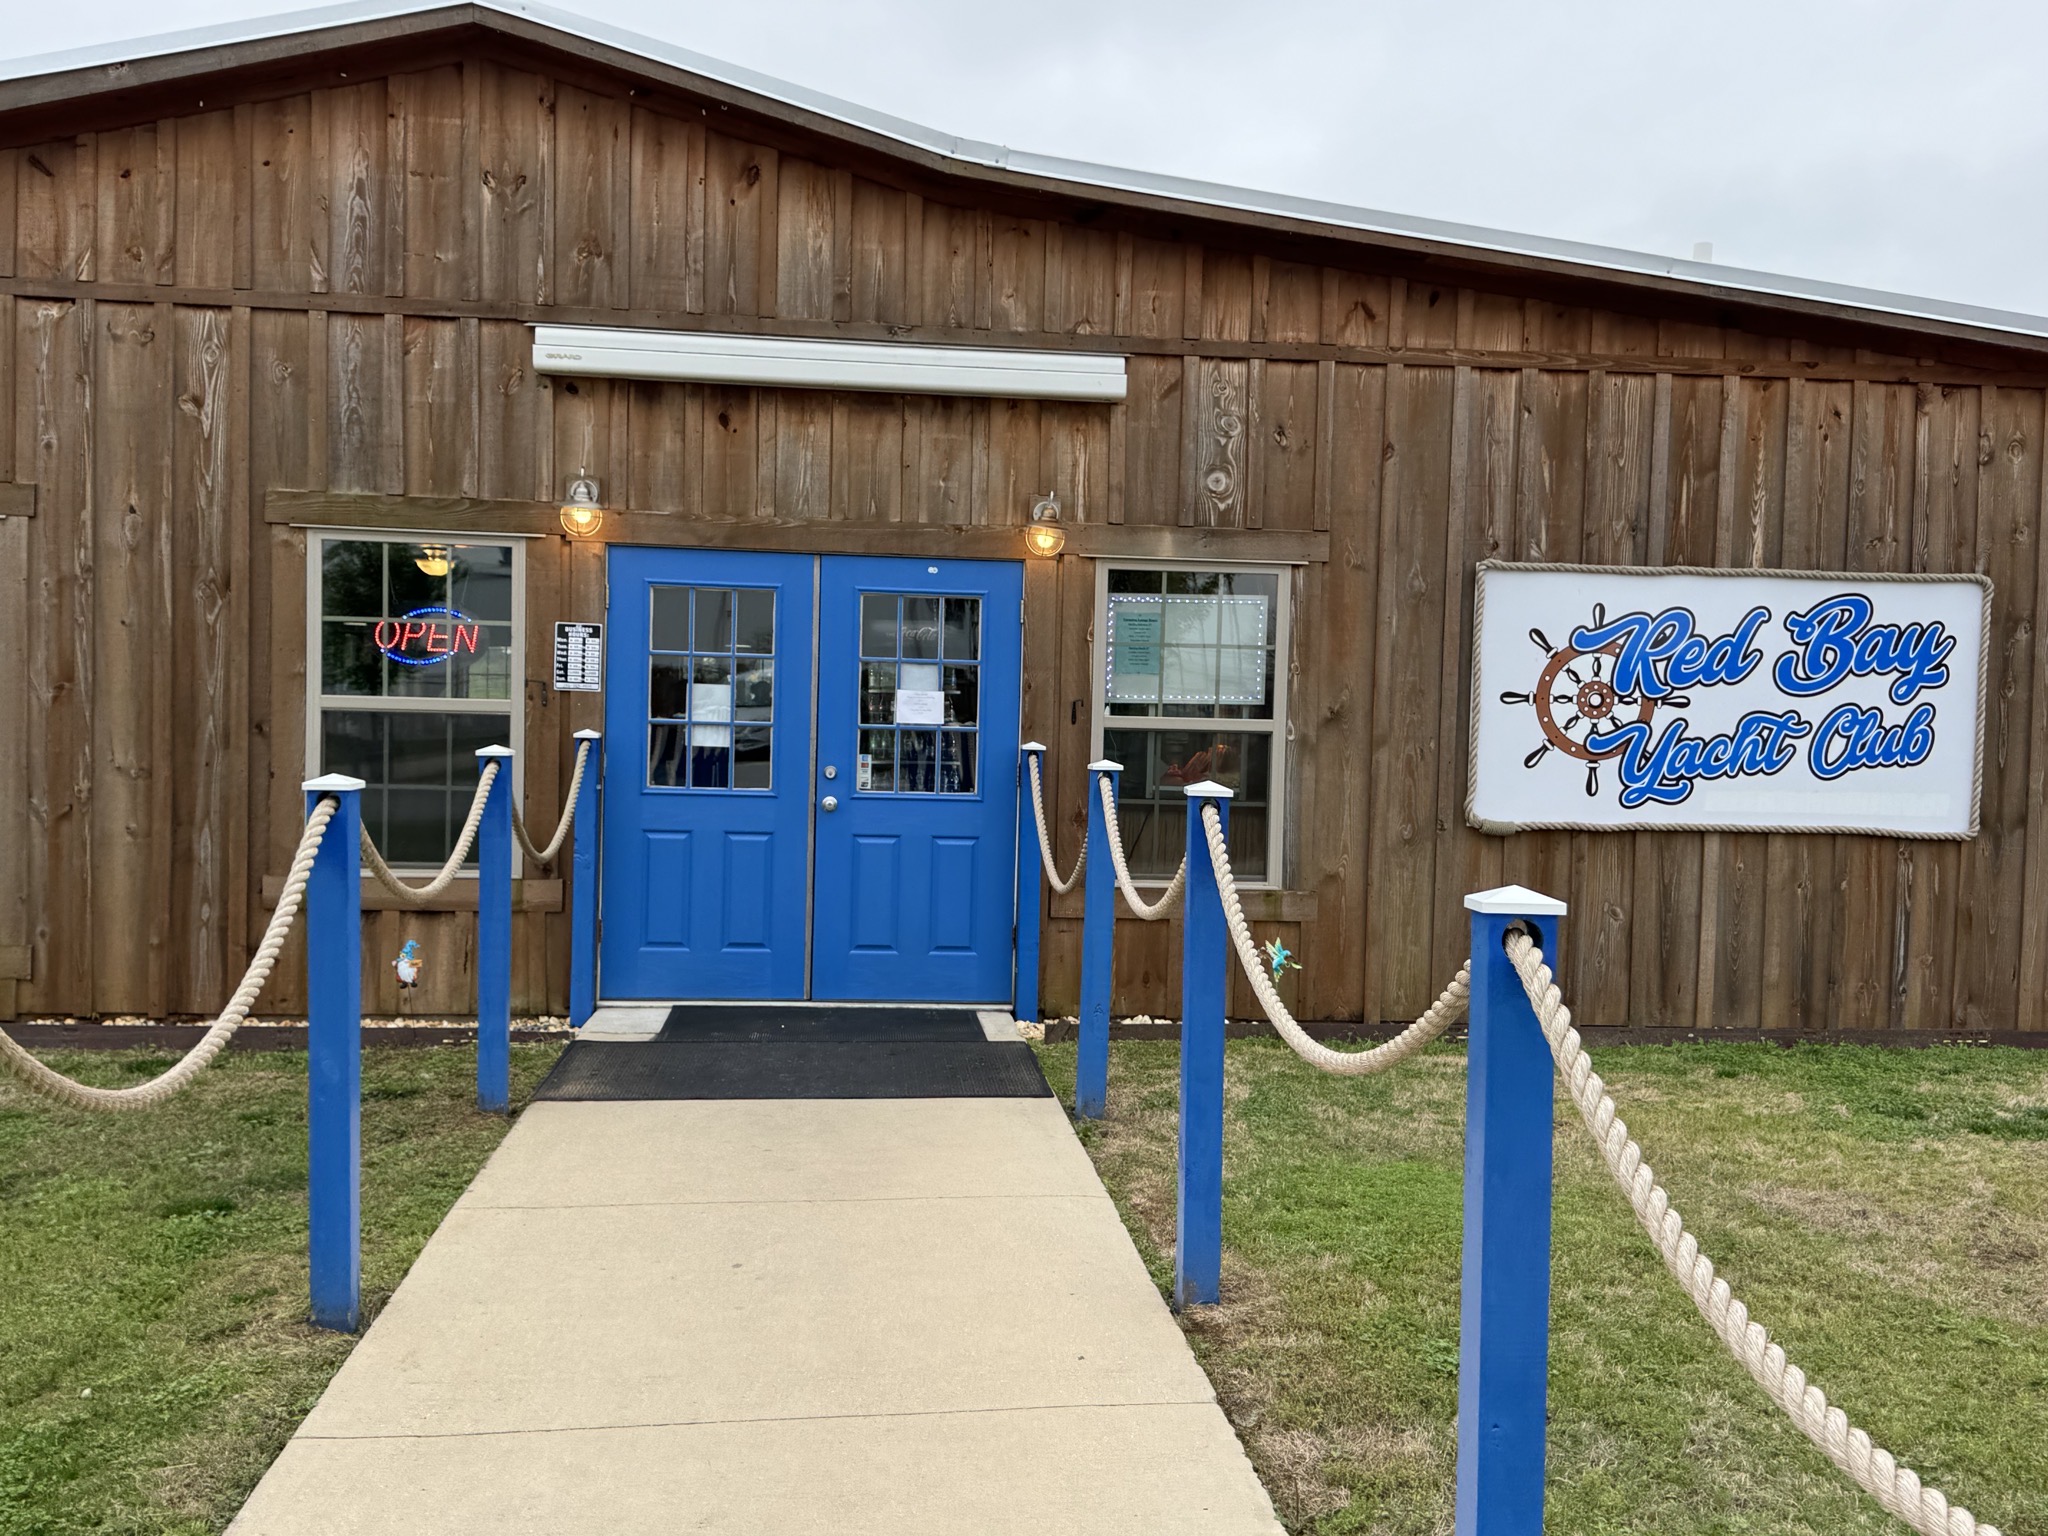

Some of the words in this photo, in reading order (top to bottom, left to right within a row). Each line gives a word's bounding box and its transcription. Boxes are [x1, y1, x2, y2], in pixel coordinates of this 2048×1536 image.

[374, 620, 479, 654] OPEN
[1569, 605, 1771, 698] Red
[1772, 592, 1956, 704] Bay
[1586, 709, 1812, 809] Yacht
[1807, 702, 1936, 781] Club
